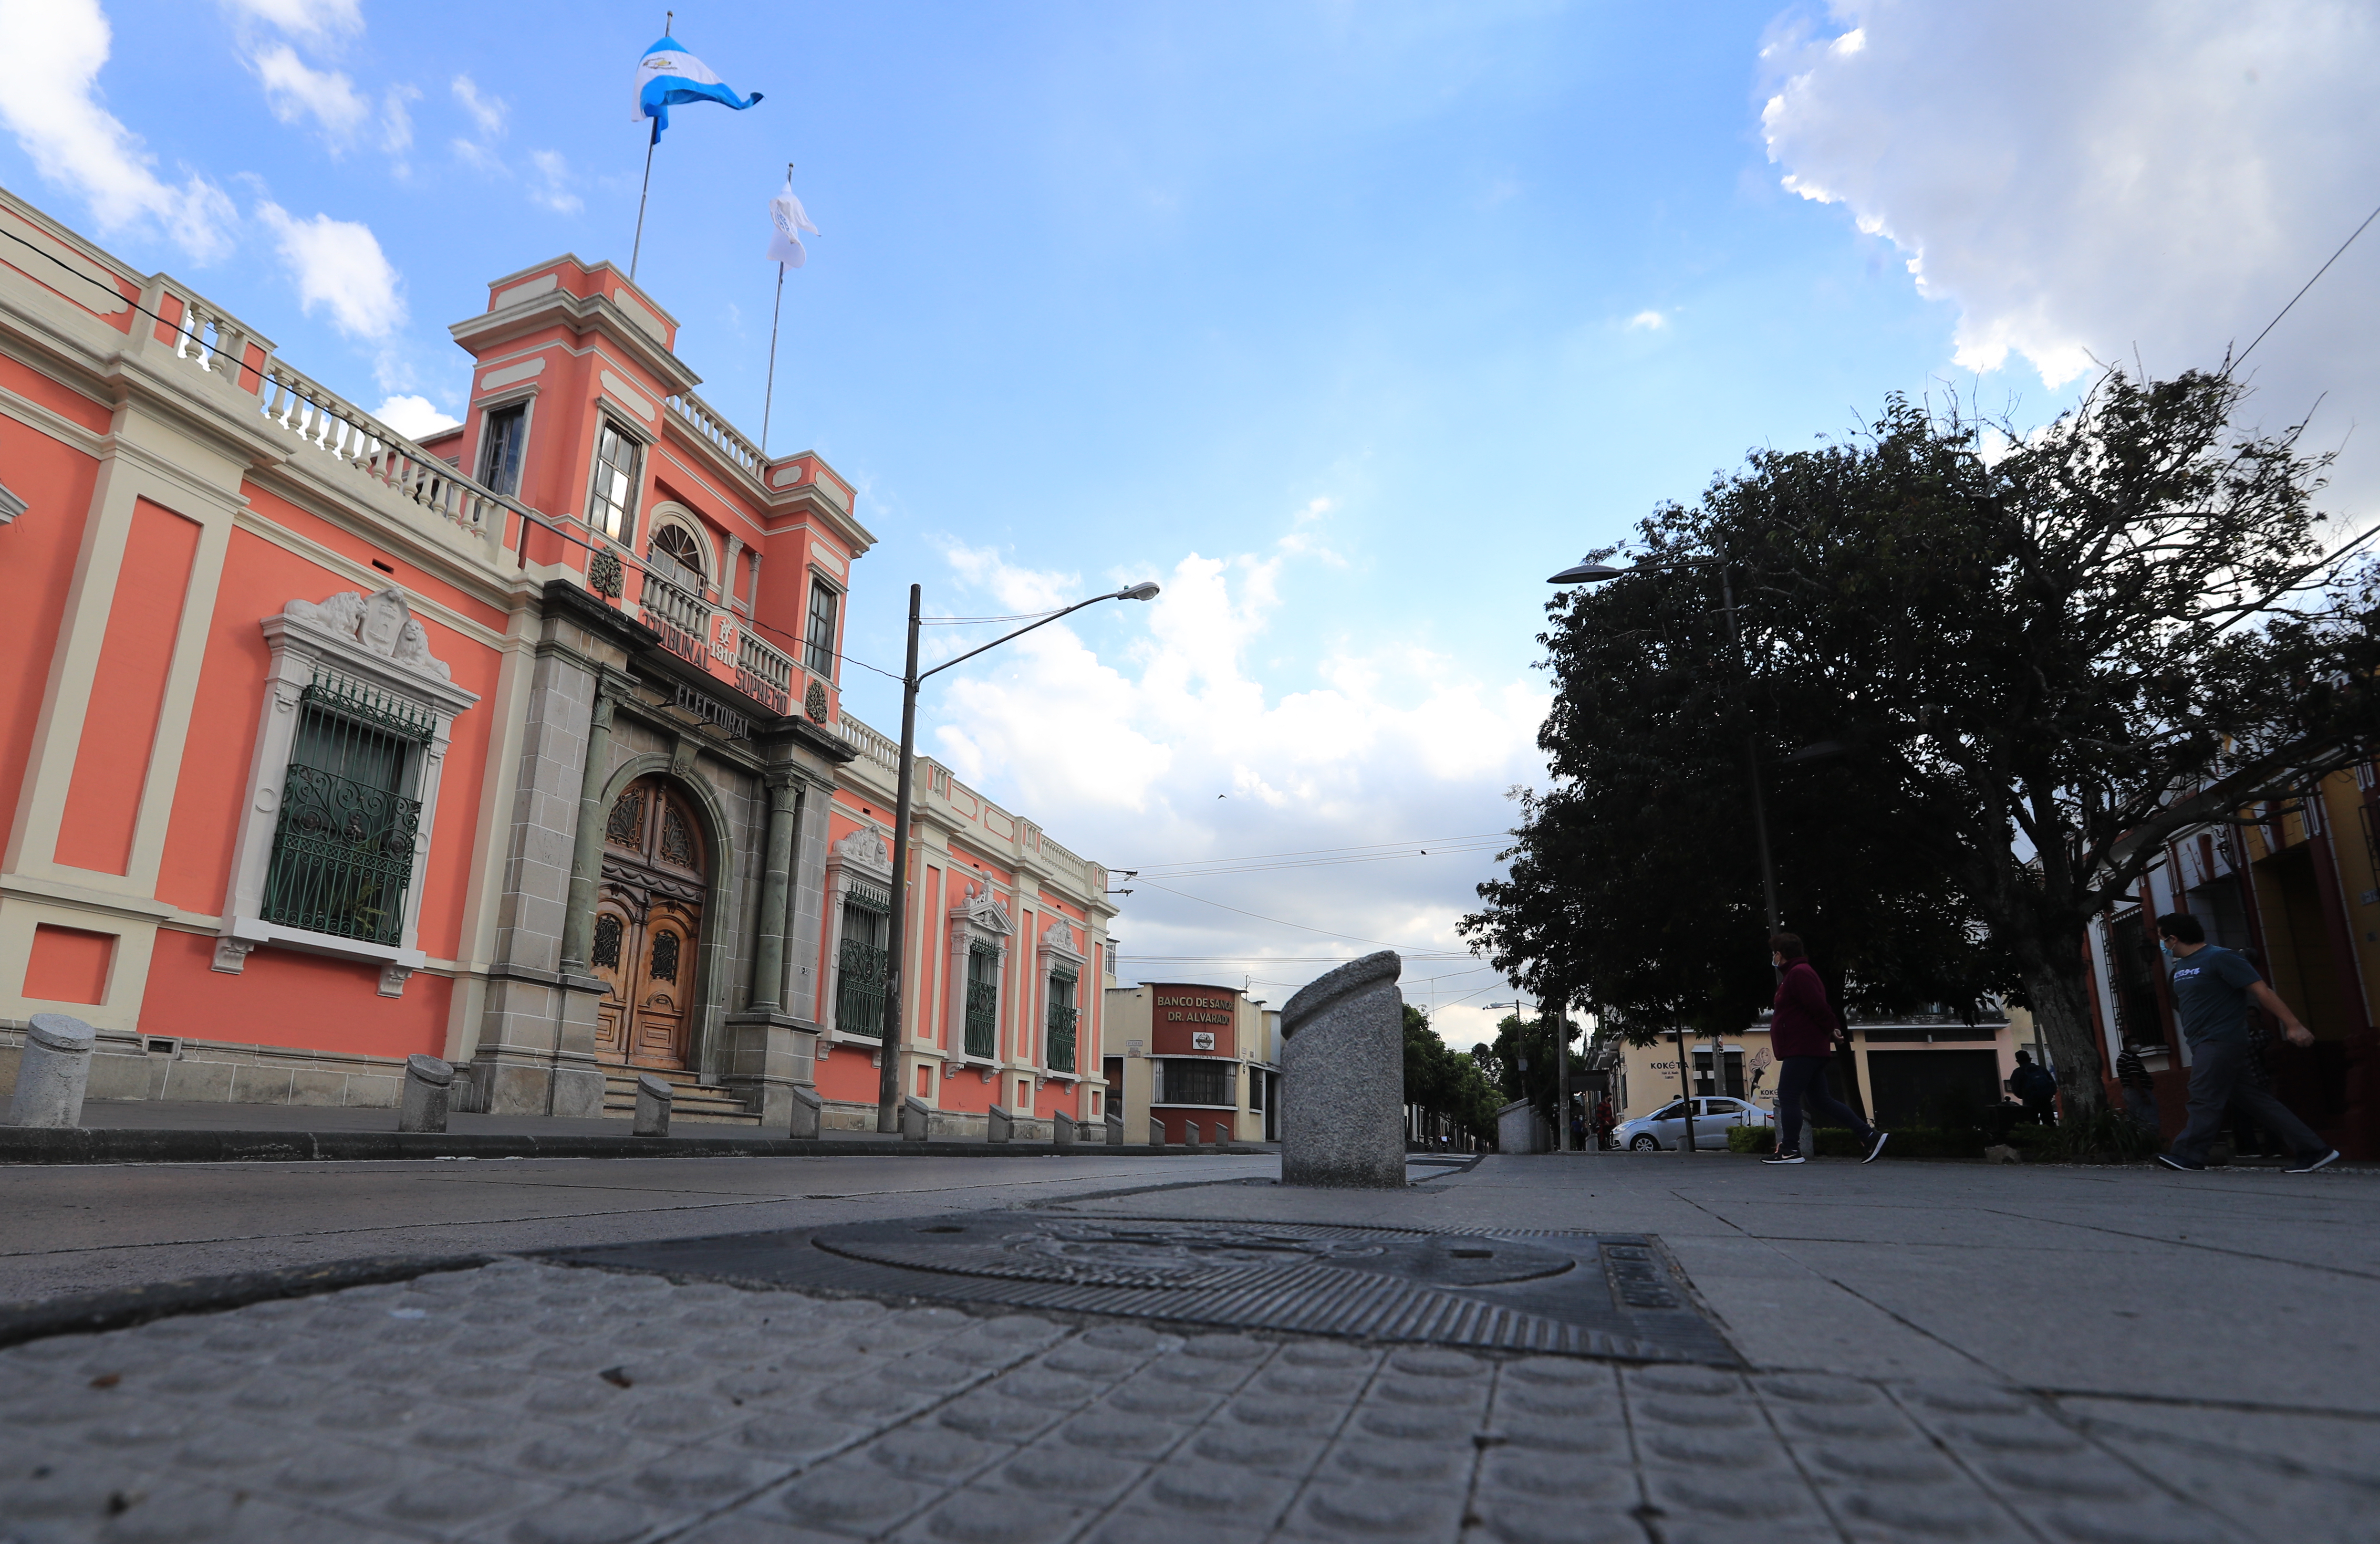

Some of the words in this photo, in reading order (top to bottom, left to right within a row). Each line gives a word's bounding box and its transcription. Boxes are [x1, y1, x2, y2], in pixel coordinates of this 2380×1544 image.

[642, 612, 711, 672] TRIBUNAL
[710, 640, 736, 668] 1910
[735, 668, 788, 715] SUPREMO
[676, 683, 752, 740] ELECTORAL
[1157, 996, 1193, 1007] BANCO
[1195, 997, 1208, 1008] DE
[1209, 999, 1235, 1012] SANGRE
[1168, 1012, 1184, 1022] DR.
[1186, 1012, 1230, 1025] ALVARADO
